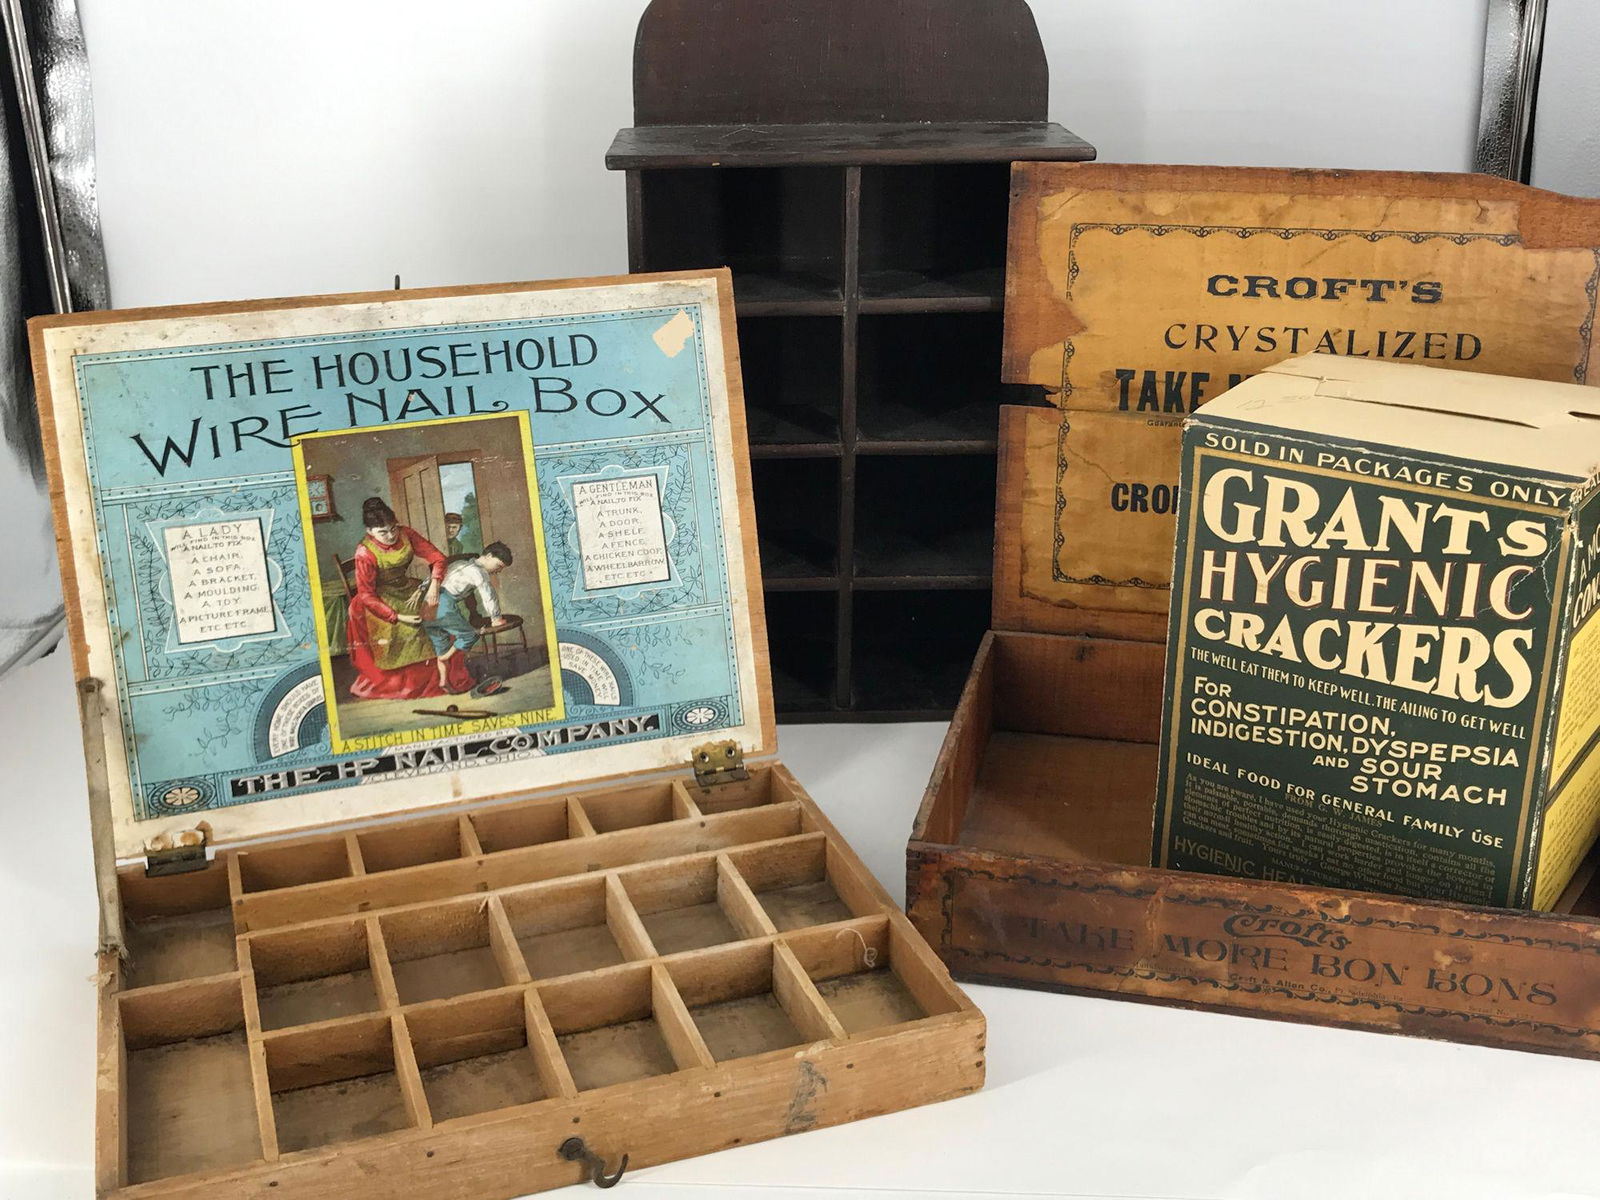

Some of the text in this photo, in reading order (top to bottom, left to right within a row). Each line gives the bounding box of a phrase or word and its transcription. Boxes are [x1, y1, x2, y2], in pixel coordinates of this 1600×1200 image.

[1206, 274, 1444, 304] CROFT'S
[1164, 323, 1482, 360] CRYSTALIZED
[190, 333, 598, 400] THE HOUSEHOLD
[1115, 368, 1211, 414] TAKE
[130, 376, 672, 478] WIRE NAIL BOX
[579, 479, 653, 495] A GENTLEMAN
[1205, 432, 1567, 506] SOLD IN PACKAGES ONLY
[182, 523, 242, 540] A LADY
[193, 568, 201, 576] A
[593, 550, 634, 560] CHICKEN
[184, 592, 193, 600] A
[1199, 549, 1536, 622] HYGIENIC
[188, 610, 234, 622] PICTURE
[1193, 607, 1534, 709] CRACKERS
[1191, 646, 1209, 663] THE
[1211, 652, 1238, 671] WELL
[1240, 660, 1260, 676] EAT
[1261, 665, 1290, 685] THEM
[1292, 673, 1305, 688] TO
[1308, 678, 1338, 696] KEEP
[1376, 694, 1397, 712] THE
[1399, 701, 1438, 720] AILING
[1441, 709, 1457, 724] TO
[1461, 714, 1486, 731] GET
[1489, 719, 1526, 740] WELL
[342, 740, 351, 753] A
[355, 732, 403, 750] STITCH
[411, 729, 425, 741] IN
[432, 723, 465, 738] TIME
[471, 717, 517, 731] SAVES
[1191, 697, 1396, 737] CONSTIPATION,
[238, 766, 332, 795] THE
[394, 742, 488, 771] NAIL
[1312, 755, 1443, 781] AND SOUR
[1352, 736, 1520, 768] DYSPEPSIA
[1186, 752, 1230, 776] IDEAL
[1237, 768, 1281, 790] FOOD
[1287, 783, 1316, 801] FOR
[1321, 793, 1395, 823] GENERAL
[1403, 815, 1464, 839] FAMILY
[1350, 775, 1508, 806] STOMACH
[1199, 778, 1214, 787] you
[1328, 817, 1368, 835] Hygienic
[1370, 829, 1410, 845] Crackers
[1413, 840, 1427, 850] for
[1285, 792, 1313, 808] FROM
[1350, 813, 1383, 829] JAMES
[1174, 835, 1256, 876] HYGIENIC
[1223, 914, 1353, 950] Croft's
[1163, 934, 1289, 972] MORE
[1311, 952, 1410, 987] BON
[1425, 968, 1558, 1006] BONS
[1276, 979, 1305, 990] Allen
